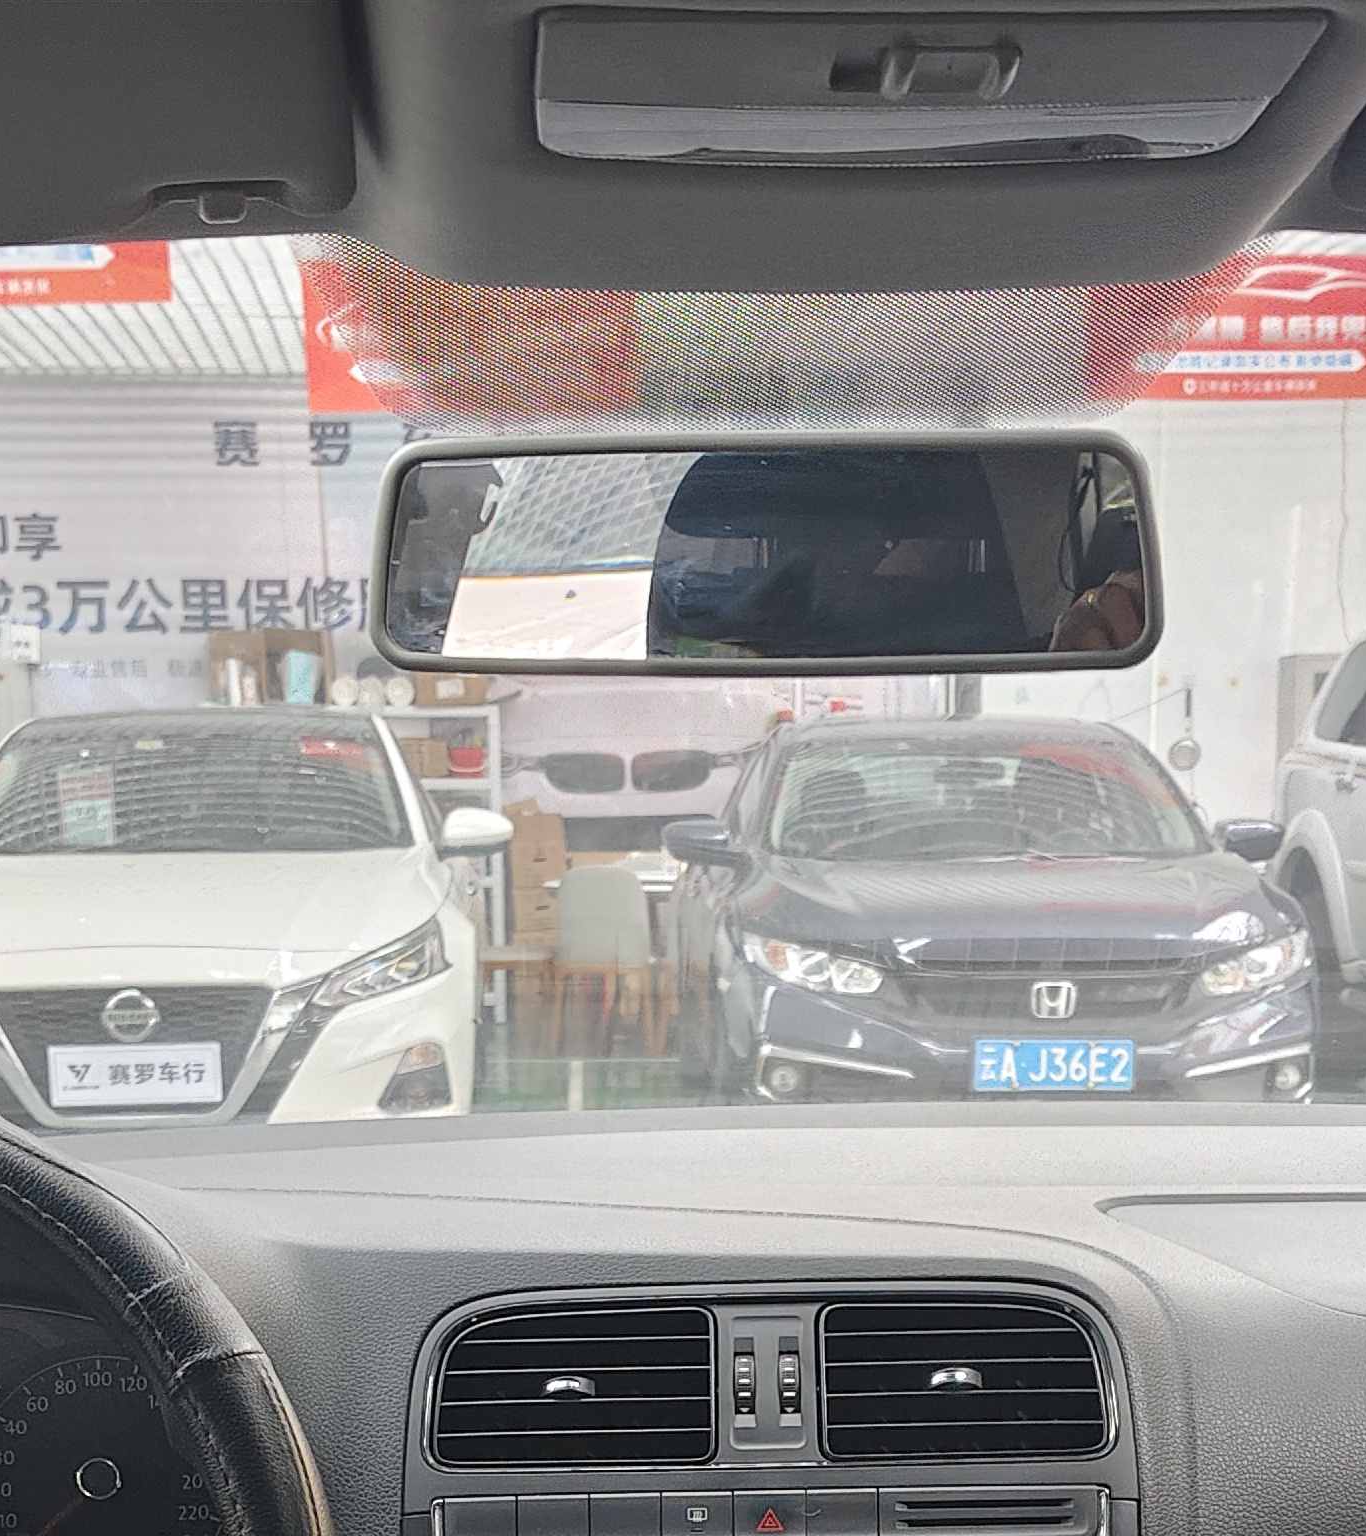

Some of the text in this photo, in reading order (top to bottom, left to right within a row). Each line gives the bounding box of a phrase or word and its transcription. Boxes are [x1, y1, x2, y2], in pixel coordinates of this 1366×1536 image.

[108, 1061, 206, 1086] 赛罗车行
[54, 1379, 77, 1395] 80
[84, 1371, 112, 1387] 100
[120, 1376, 148, 1392] 120
[26, 1397, 49, 1412] 60
[4, 1420, 28, 1435] 40
[182, 1474, 203, 1490] 20
[0, 1513, 17, 1528] 10
[178, 1505, 210, 1521] 220
